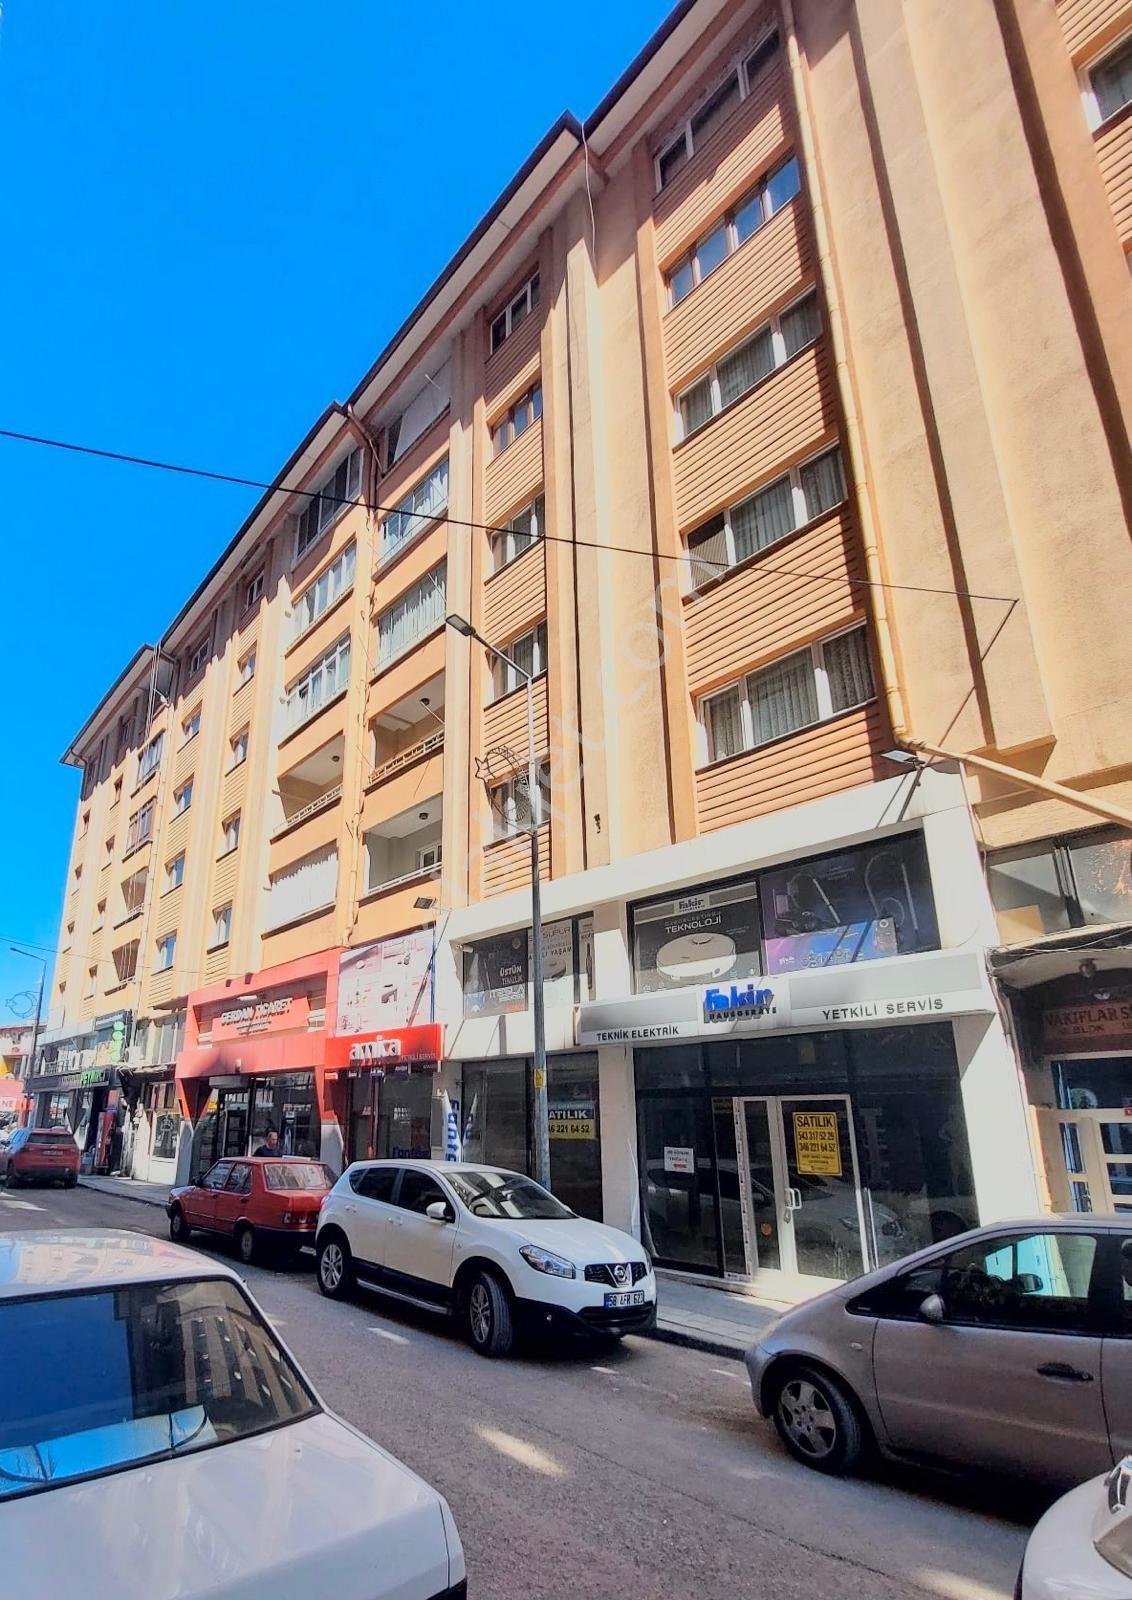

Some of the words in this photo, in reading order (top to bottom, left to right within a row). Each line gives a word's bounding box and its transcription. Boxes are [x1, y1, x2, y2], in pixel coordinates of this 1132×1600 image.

[886, 997, 944, 1015] SERVİS
[597, 1030, 629, 1041] TEKNİK
[631, 1026, 679, 1038] ELEKTRİK
[548, 1110, 588, 1119] ATILIK
[797, 1116, 833, 1128] SATILIK
